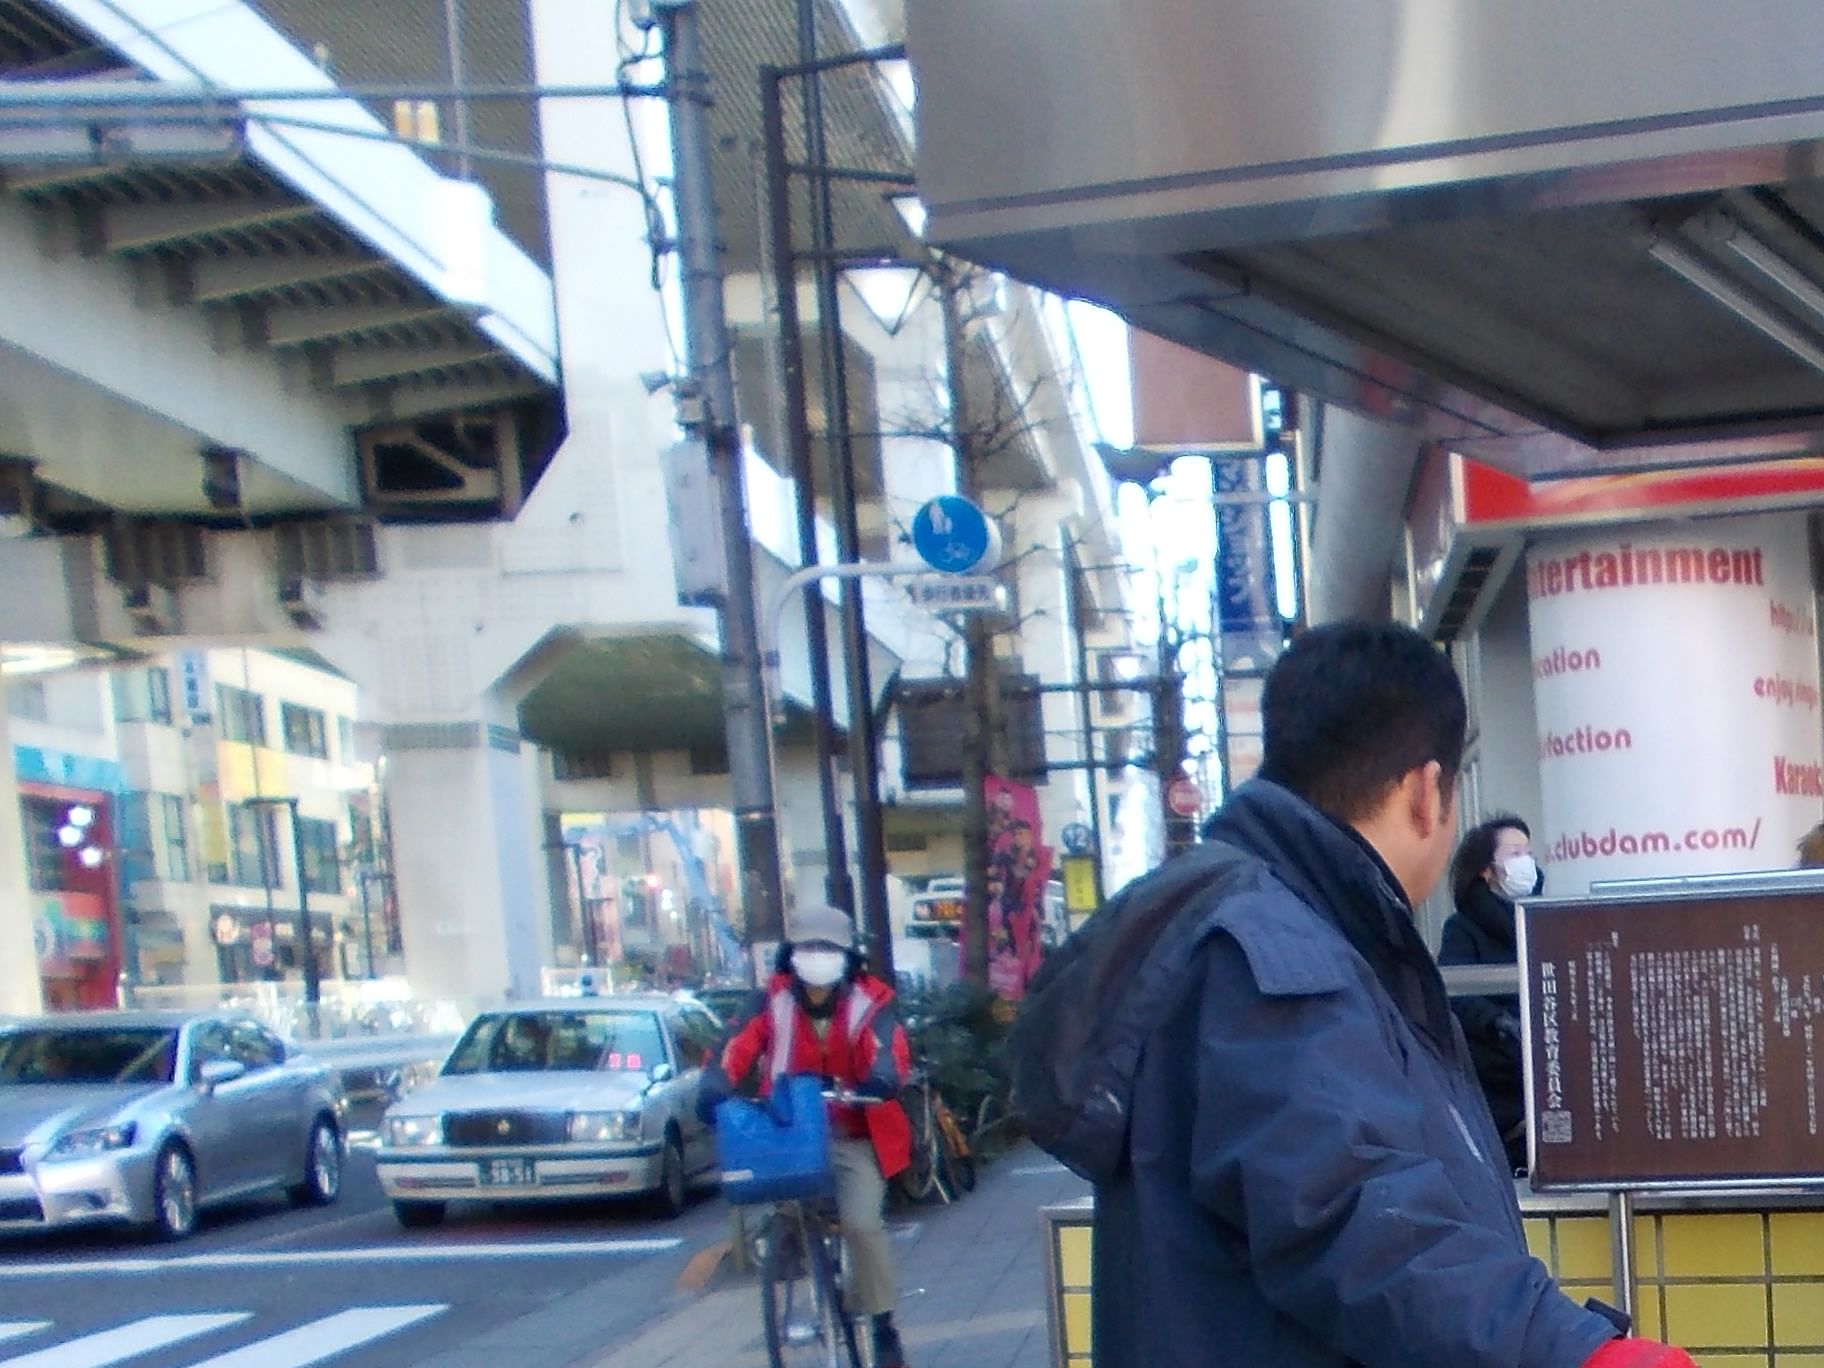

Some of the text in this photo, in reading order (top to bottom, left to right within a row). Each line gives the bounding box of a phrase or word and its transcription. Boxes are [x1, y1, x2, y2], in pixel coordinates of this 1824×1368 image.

[1541, 961, 1563, 1109] 世田谷区教育委員会
